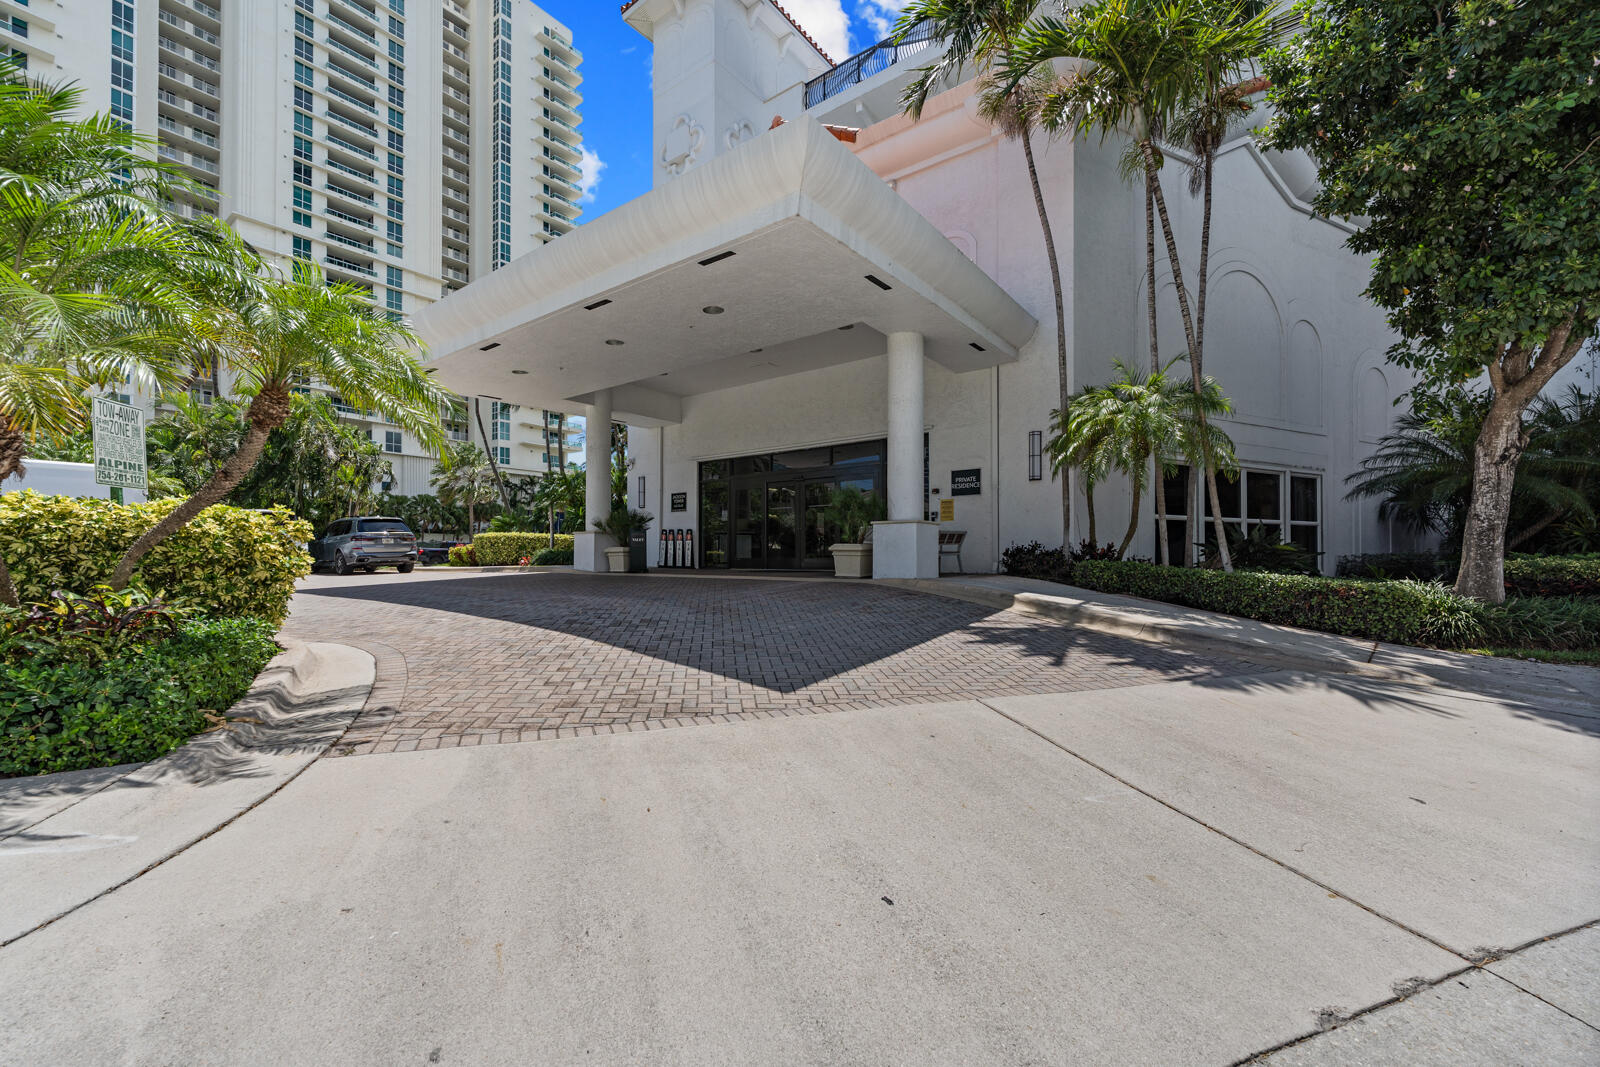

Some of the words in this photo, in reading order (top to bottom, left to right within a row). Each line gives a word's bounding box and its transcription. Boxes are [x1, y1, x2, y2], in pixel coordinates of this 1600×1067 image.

[98, 401, 140, 426] TOW-AWAY
[110, 420, 130, 438] ZONE
[98, 457, 144, 472] ALPINE
